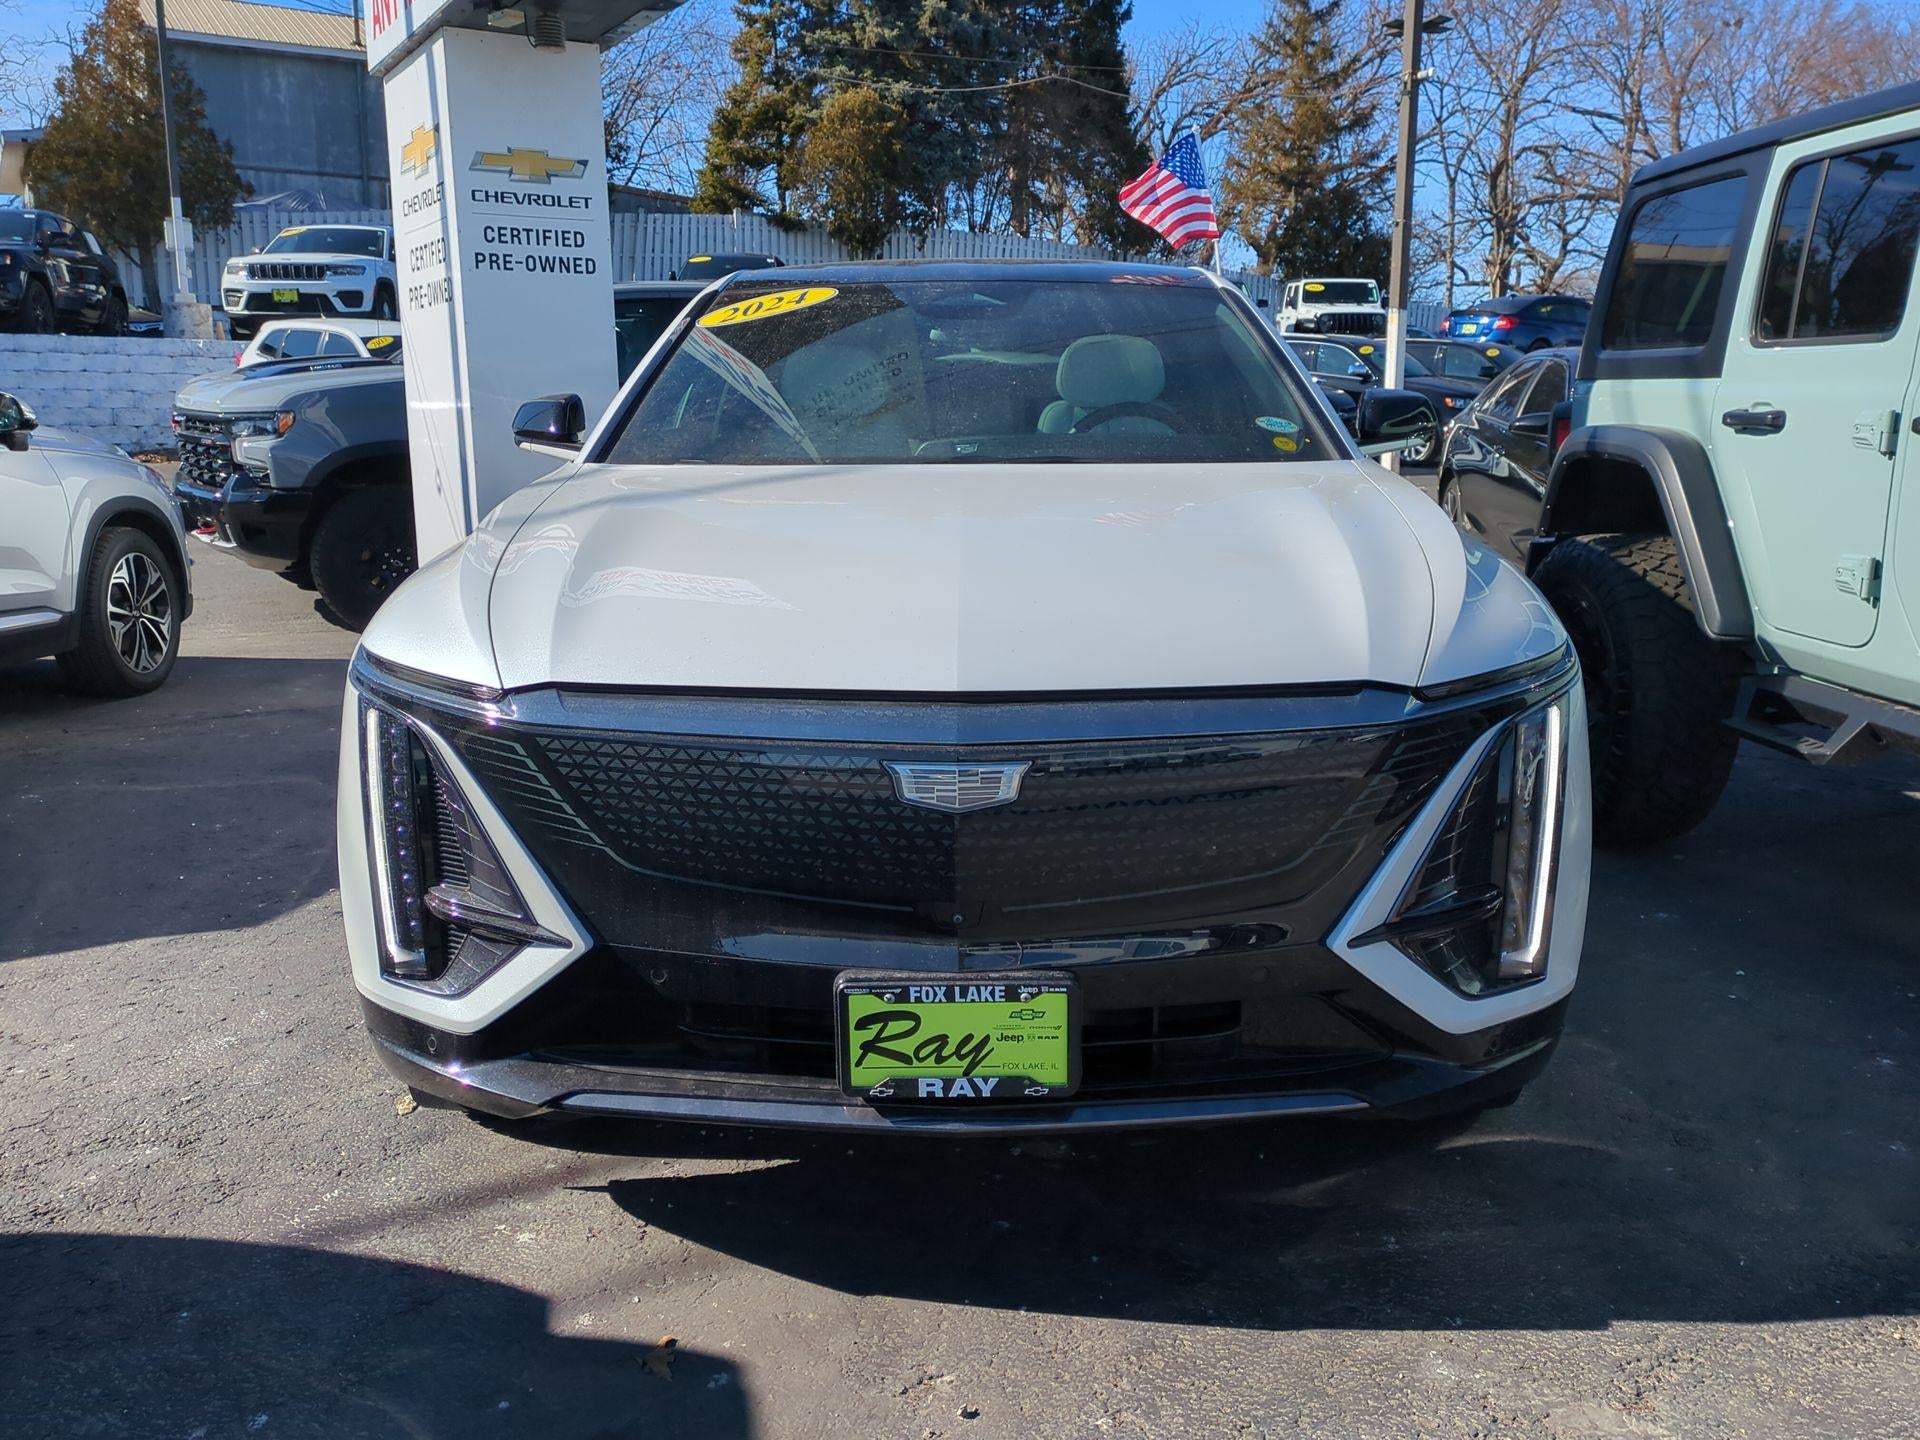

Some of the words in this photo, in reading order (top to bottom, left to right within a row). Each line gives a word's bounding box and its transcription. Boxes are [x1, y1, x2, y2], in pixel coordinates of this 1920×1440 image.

[403, 181, 445, 217] CHEVROLET
[471, 189, 593, 209] CHEVROLET
[483, 225, 585, 248] CERTIFIED
[410, 237, 446, 272] CERTIFIED
[474, 251, 597, 275] PRE-OWNED
[409, 277, 453, 311] PRE-OWNED
[719, 290, 809, 323] 2024
[909, 986, 948, 1003] FOX
[954, 986, 1006, 1003] LAKE
[1018, 986, 1039, 994] Jeep
[854, 1010, 995, 1076] Ray
[996, 1033, 1025, 1043] Jeep
[1002, 1062, 1020, 1070] FOX
[1022, 1062, 1048, 1071] LAKE,
[1051, 1062, 1059, 1070] IL
[918, 1078, 999, 1097] RAY
